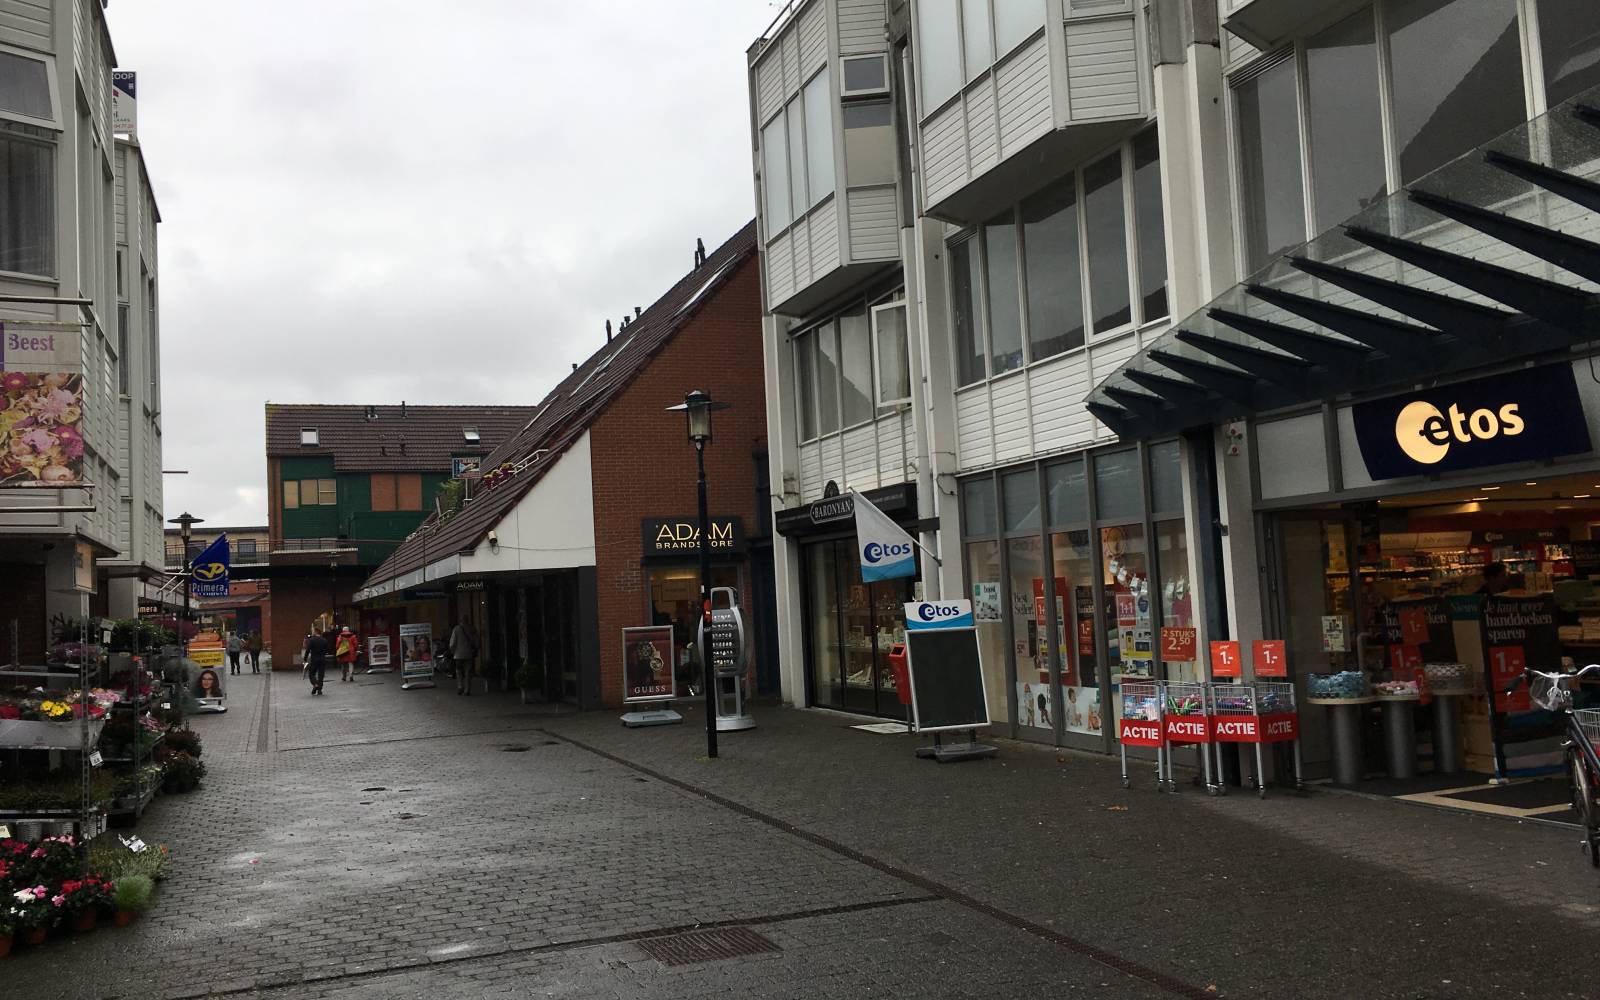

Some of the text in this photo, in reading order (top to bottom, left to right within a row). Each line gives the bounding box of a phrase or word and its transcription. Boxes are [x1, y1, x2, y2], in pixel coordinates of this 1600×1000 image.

[1395, 400, 1525, 464] etos
[814, 499, 851, 519] BARONYAN
[656, 540, 734, 549] BRANDSORE
[864, 542, 911, 563] etos
[192, 583, 225, 592] Primera
[918, 603, 960, 621] etos
[1169, 630, 1195, 638] STUKS
[634, 686, 667, 694] GUESS
[1123, 726, 1159, 740] ACTIE
[1167, 721, 1205, 736] ACTIE
[1216, 722, 1256, 735] ACTIE
[1267, 720, 1293, 735] ACTIE
